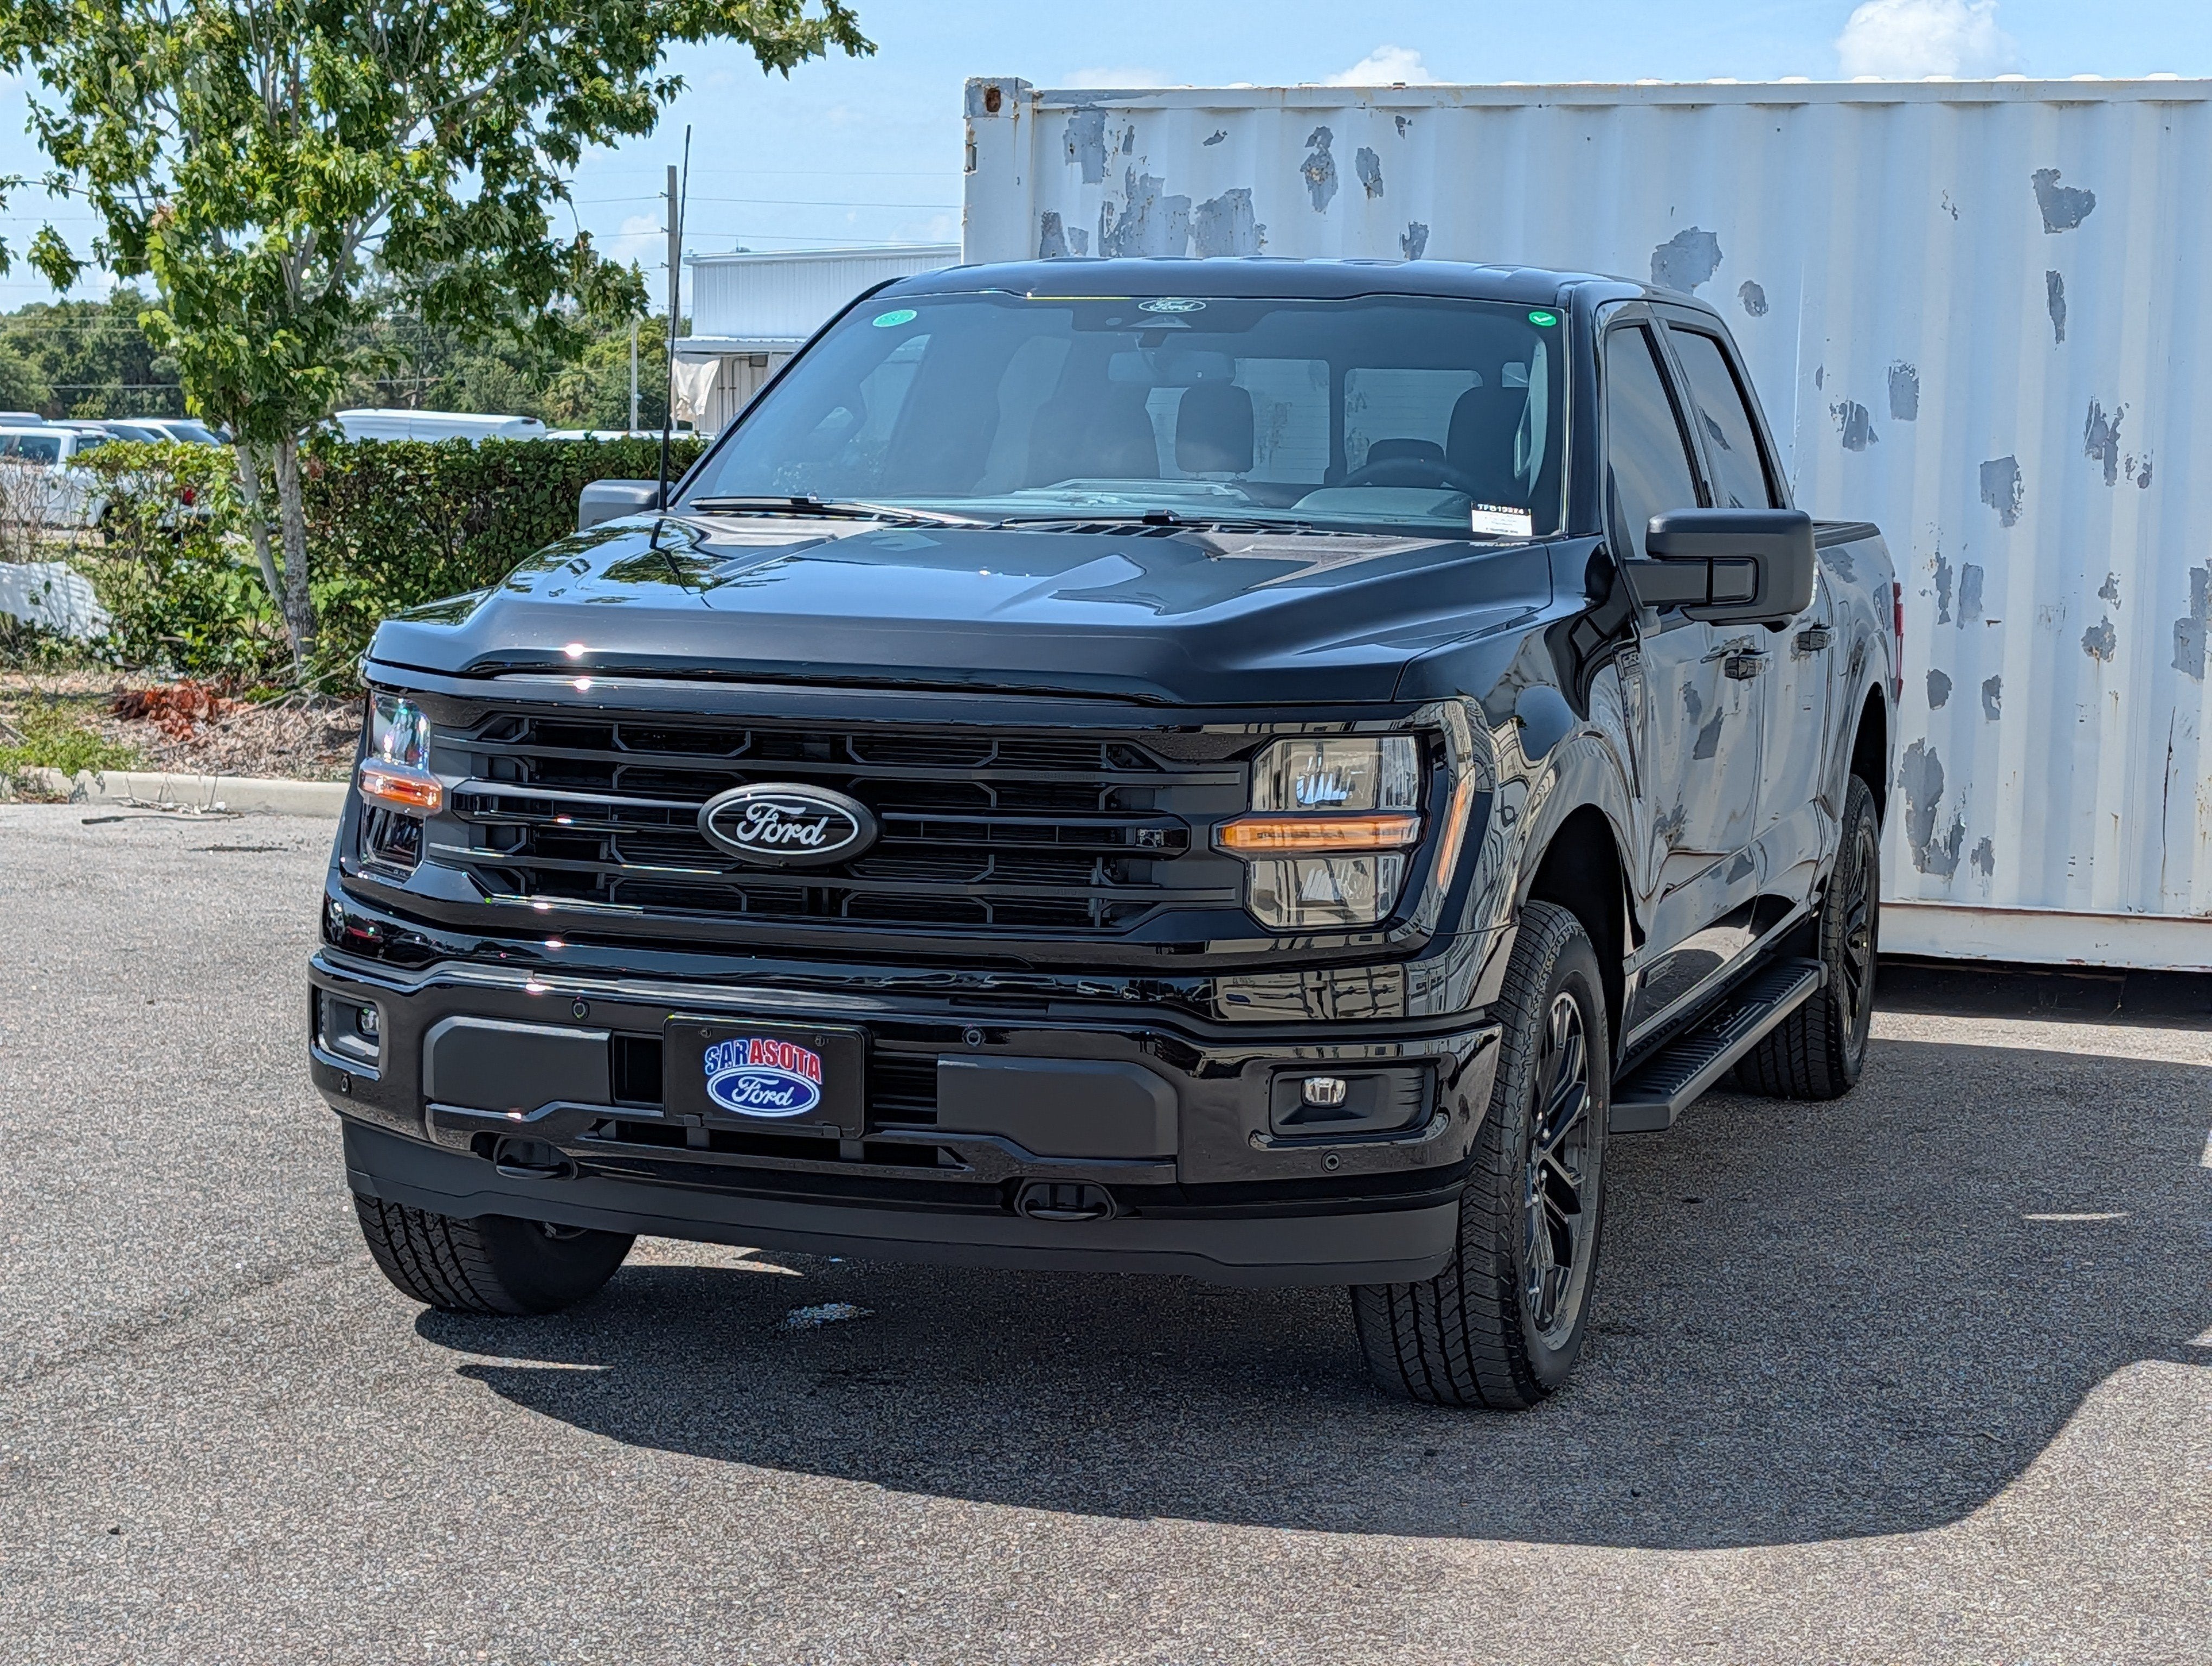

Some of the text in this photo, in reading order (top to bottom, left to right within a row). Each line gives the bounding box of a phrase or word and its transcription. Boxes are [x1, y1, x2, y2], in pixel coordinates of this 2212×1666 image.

[736, 803, 829, 846] Ford
[705, 1038, 823, 1085] SARASOTA
[731, 1075, 795, 1106] Ford
